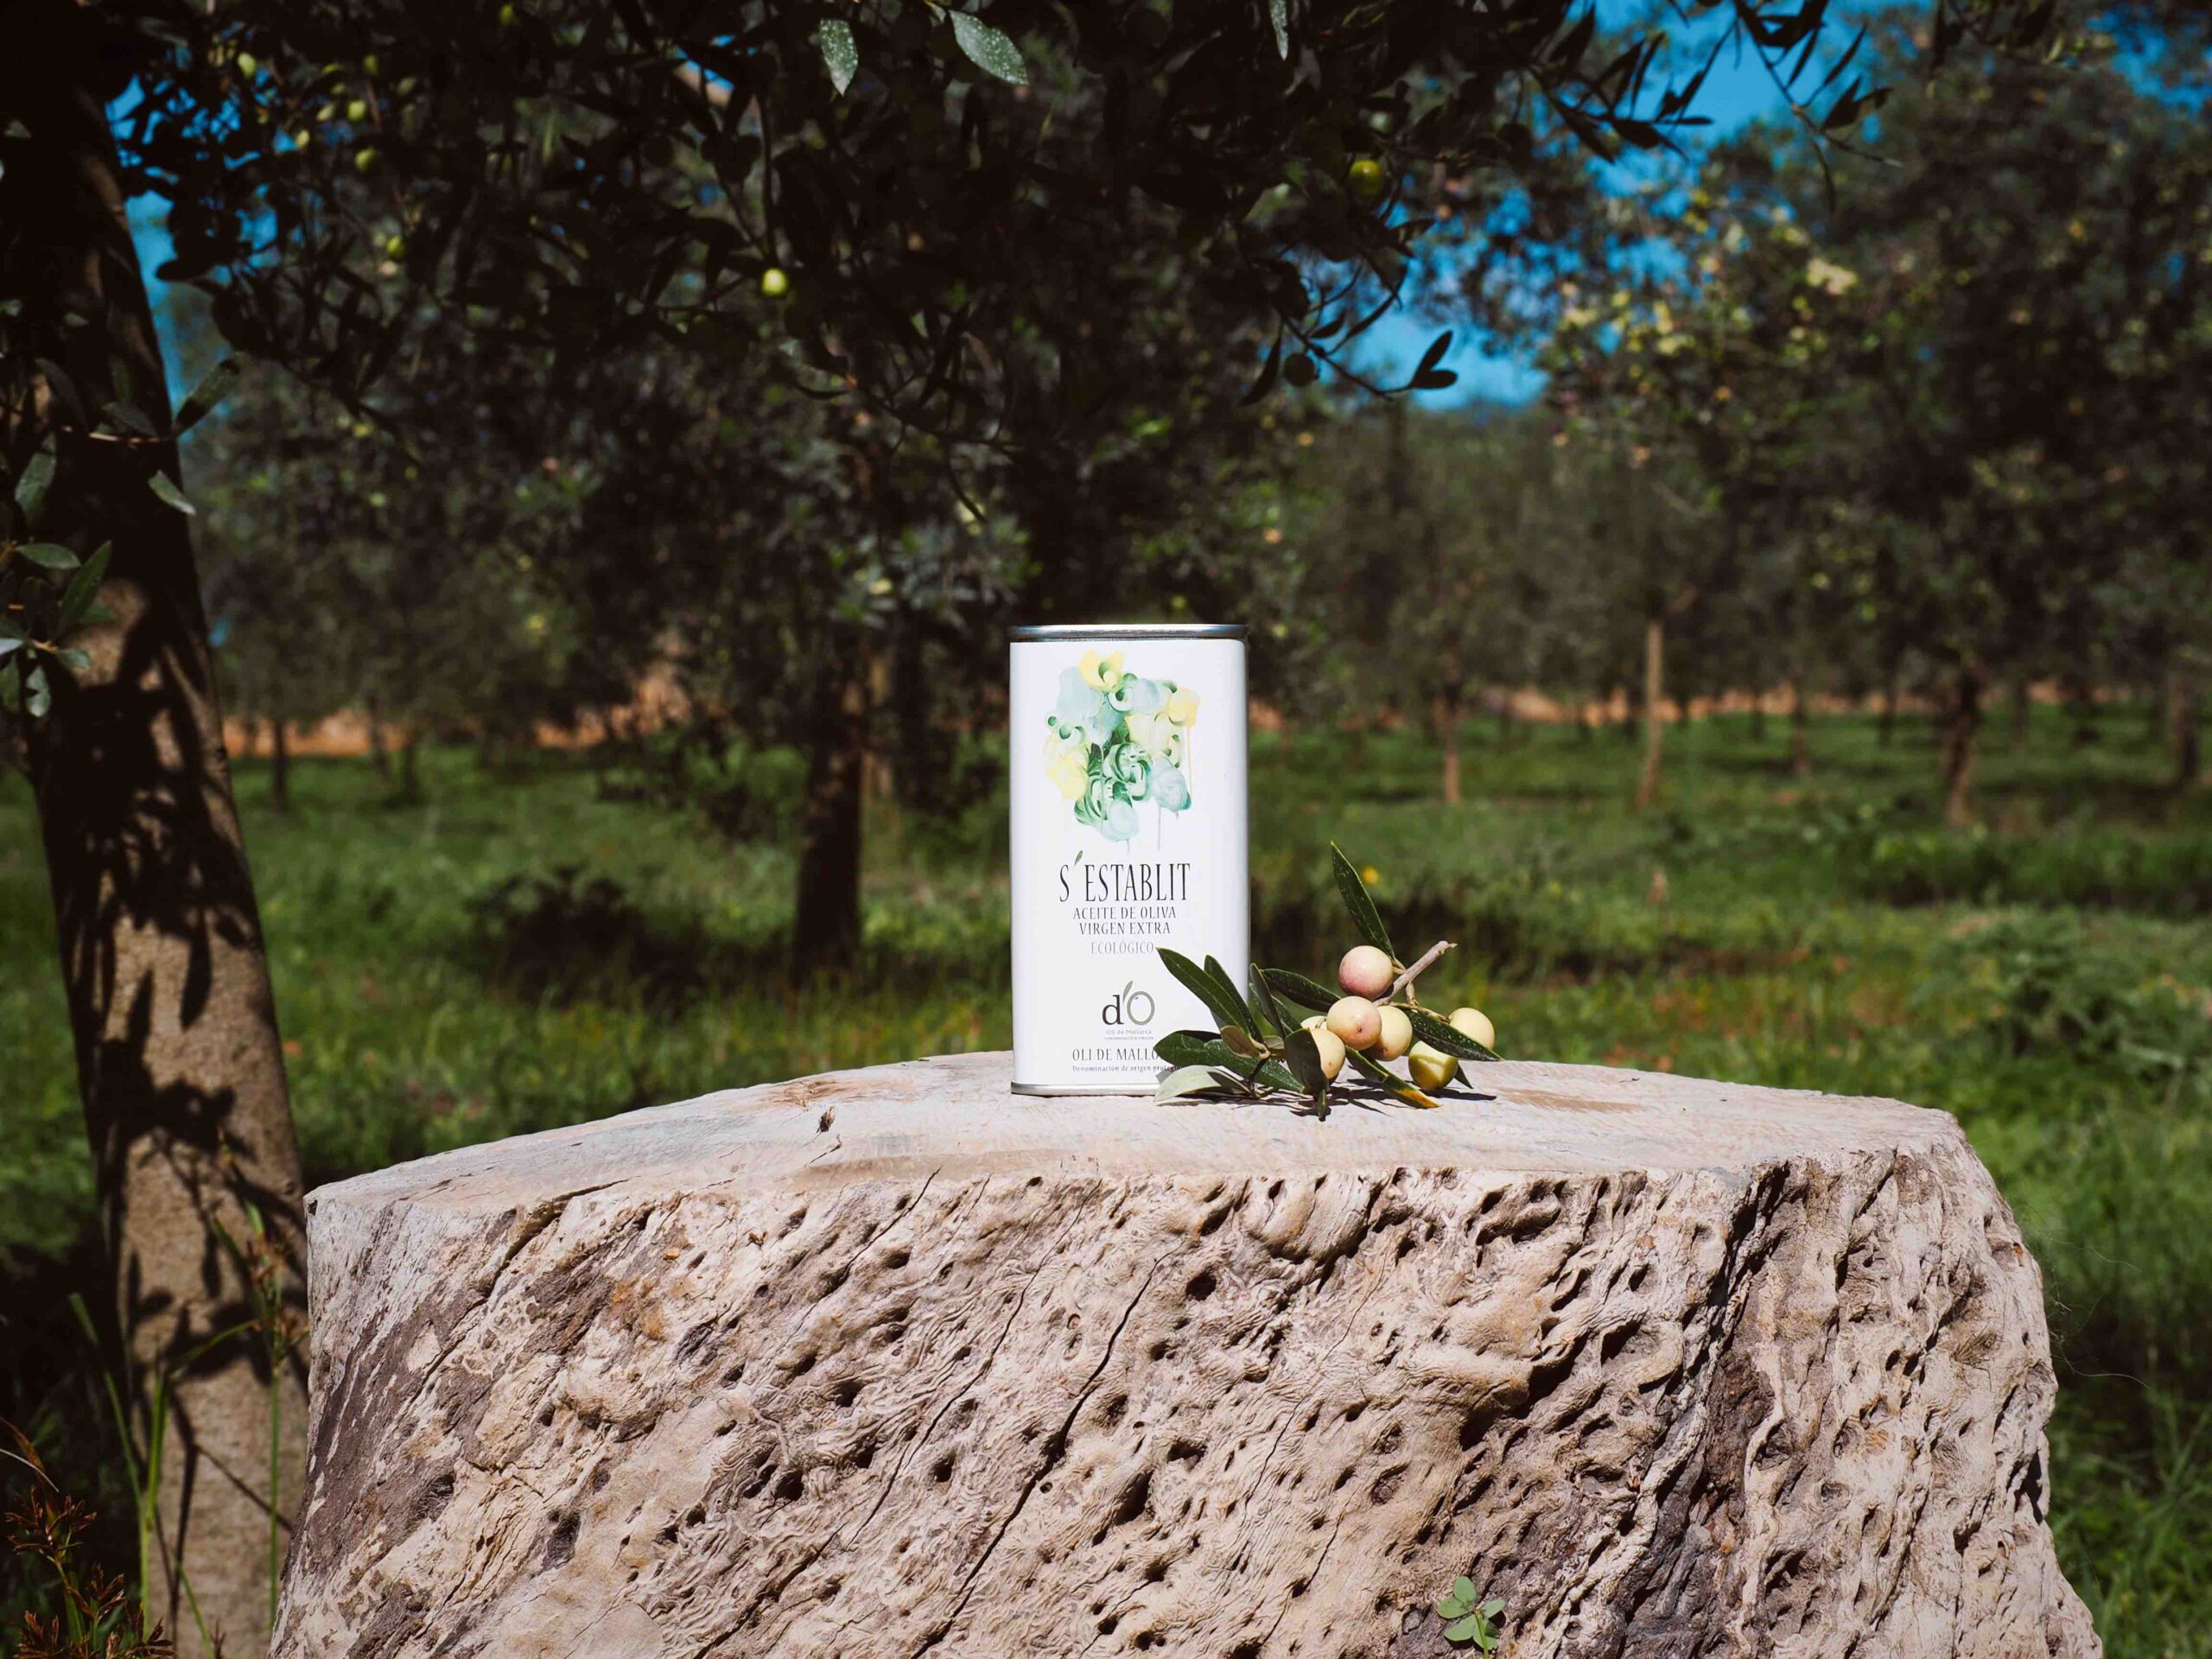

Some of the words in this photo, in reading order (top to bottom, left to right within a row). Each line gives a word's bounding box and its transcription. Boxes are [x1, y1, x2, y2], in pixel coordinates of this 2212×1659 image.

[1073, 907, 1117, 920] ACEITE
[1121, 906, 1137, 919] DE
[1141, 906, 1176, 919] OLIVA
[1079, 922, 1125, 935] VIRGEN
[1129, 921, 1171, 935] EXTRA
[1072, 1048, 1091, 1061] OLI
[1096, 1048, 1113, 1061] DE
[1116, 1048, 1158, 1061] MALLO
[1130, 1065, 1151, 1073] origen
